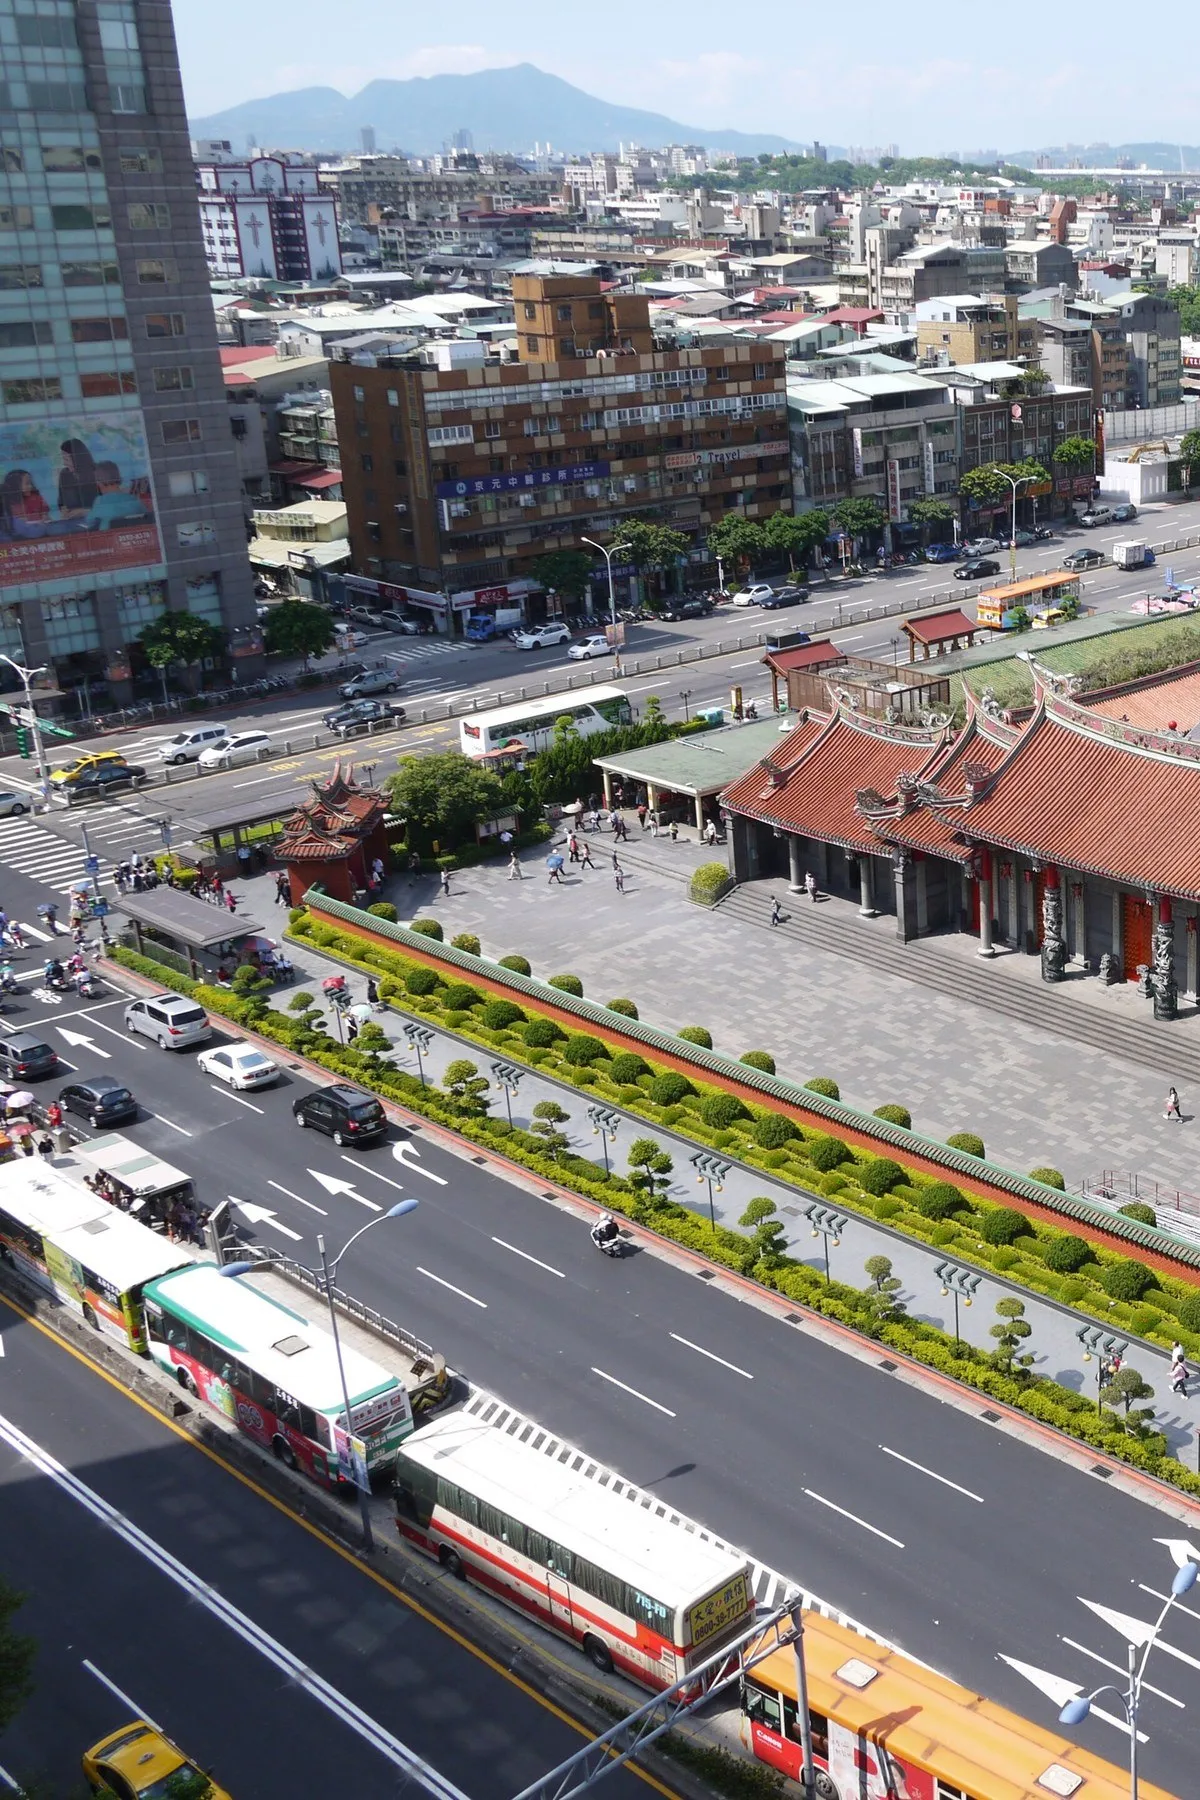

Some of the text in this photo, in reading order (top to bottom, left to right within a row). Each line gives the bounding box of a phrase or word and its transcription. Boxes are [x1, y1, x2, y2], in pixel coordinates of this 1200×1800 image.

[708, 448, 740, 464] Travel
[474, 469, 568, 491] 京元中醫診所
[756, 1729, 783, 1749] Canon
